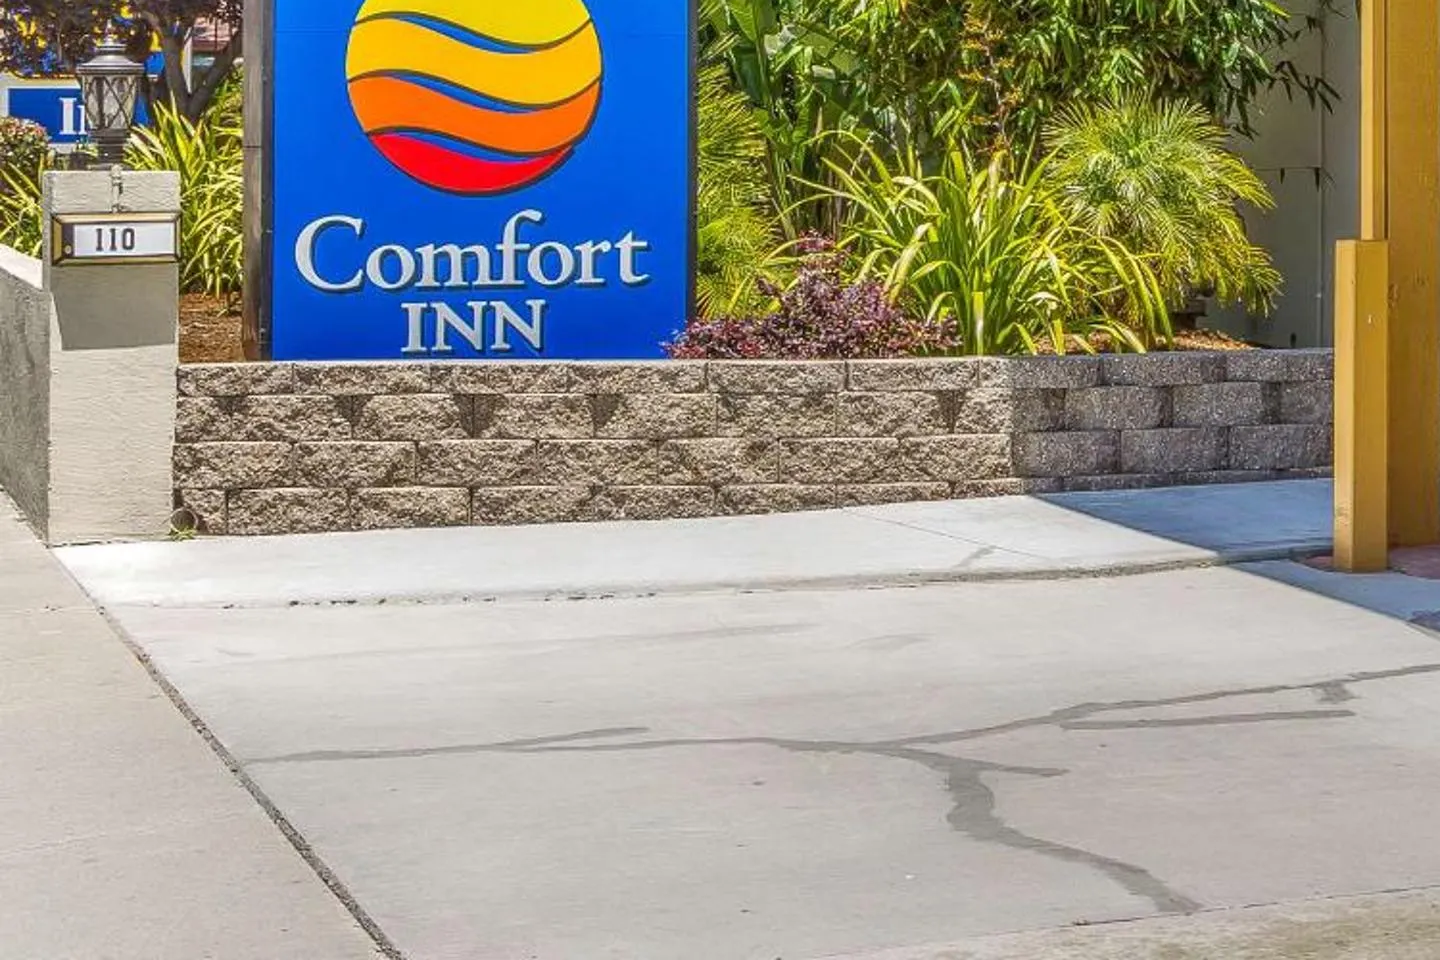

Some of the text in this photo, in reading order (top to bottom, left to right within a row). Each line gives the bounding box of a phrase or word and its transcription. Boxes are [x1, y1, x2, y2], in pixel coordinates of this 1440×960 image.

[95, 227, 136, 252] 110
[294, 208, 651, 292] Comfort
[401, 298, 547, 354] INN
